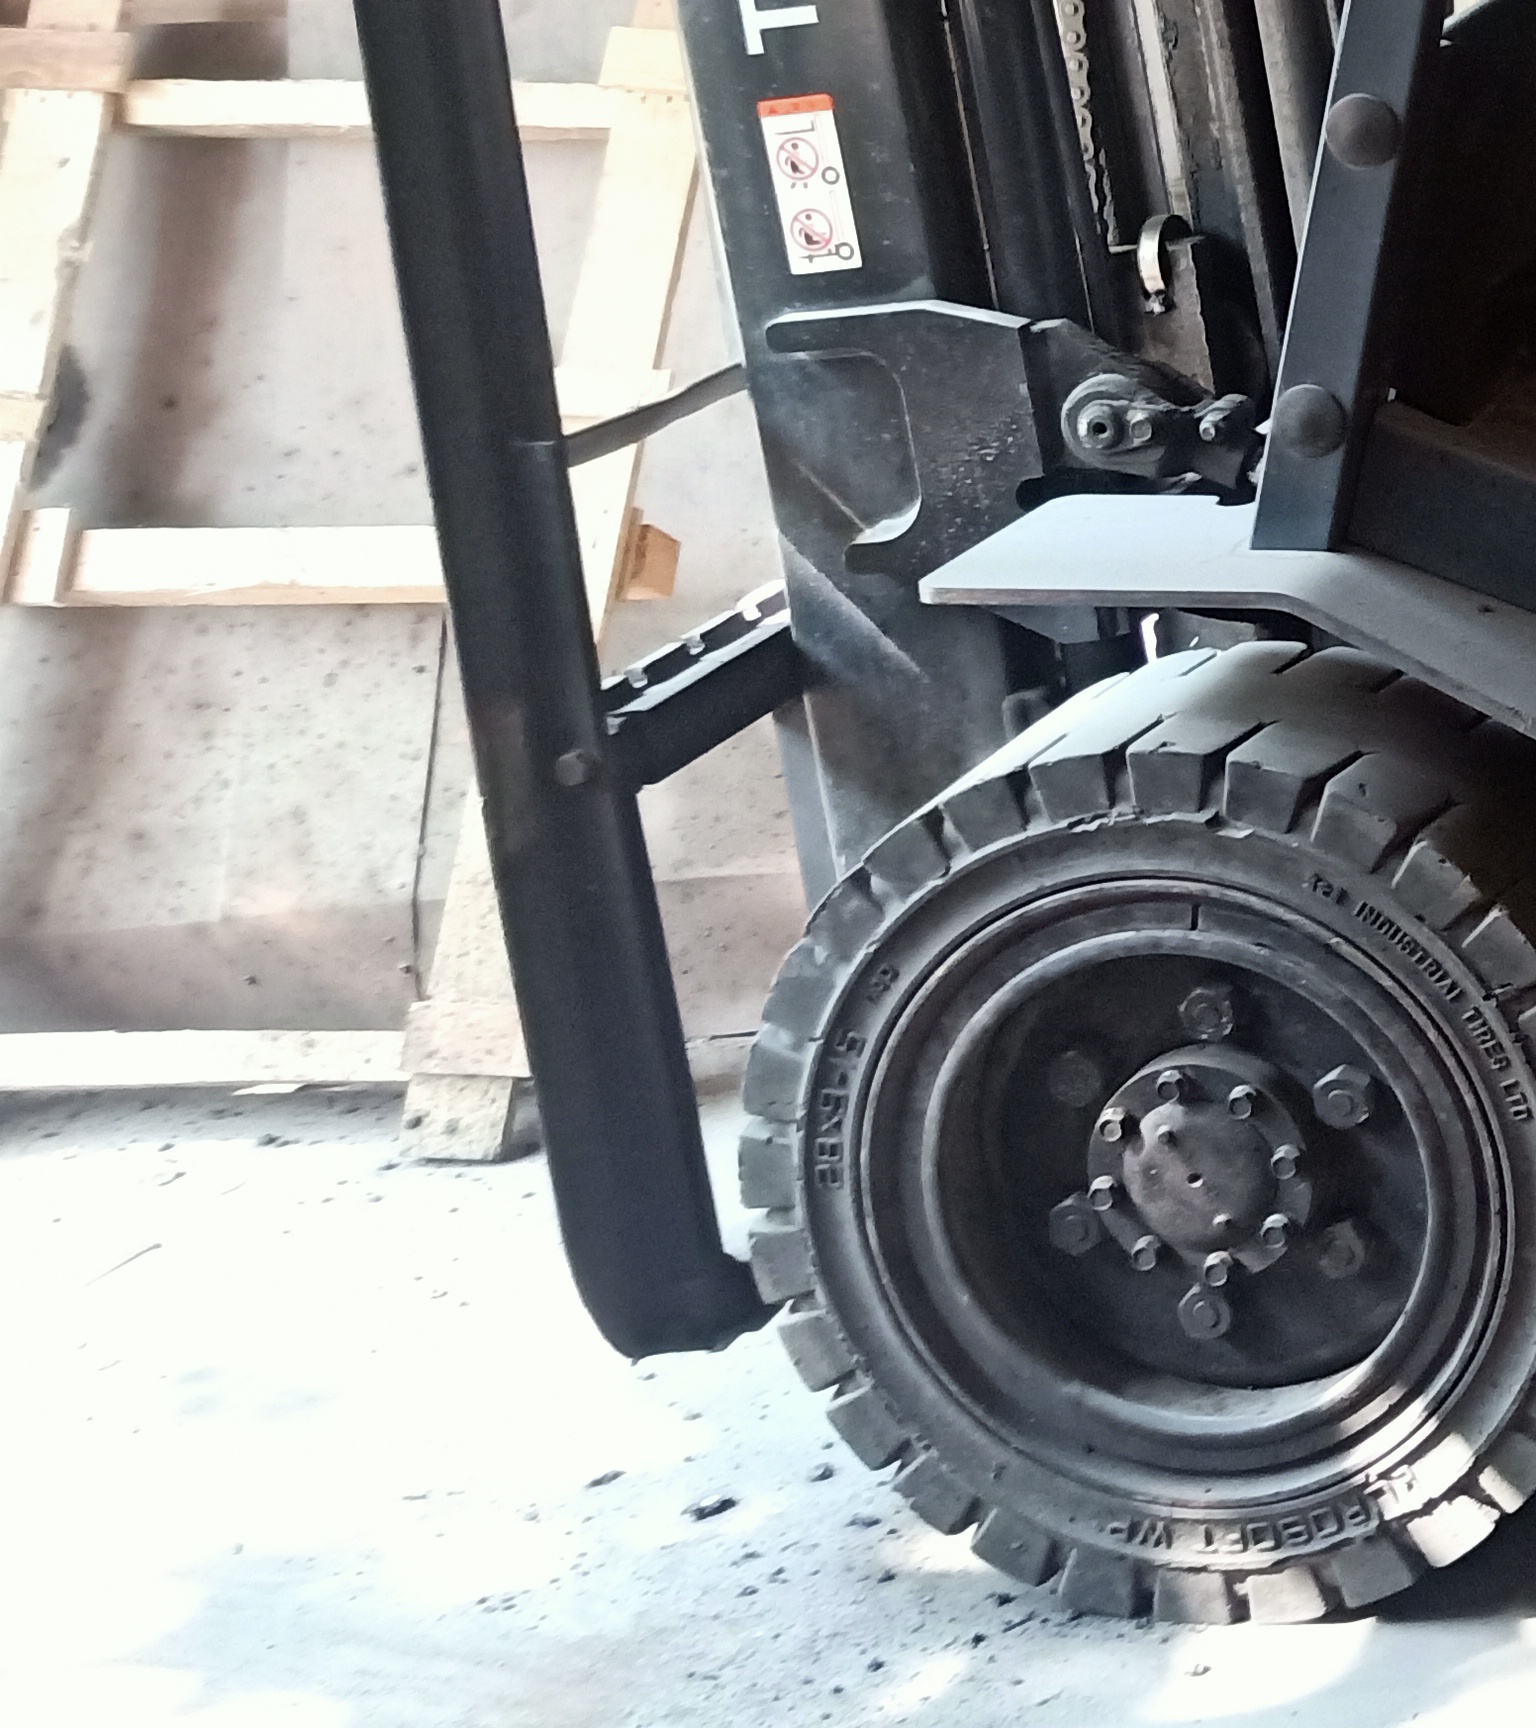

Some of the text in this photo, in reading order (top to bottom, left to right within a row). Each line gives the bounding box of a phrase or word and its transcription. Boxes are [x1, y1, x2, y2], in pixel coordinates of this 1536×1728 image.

[1353, 901, 1534, 1122] INDUSTRIAL TIRES LTD
